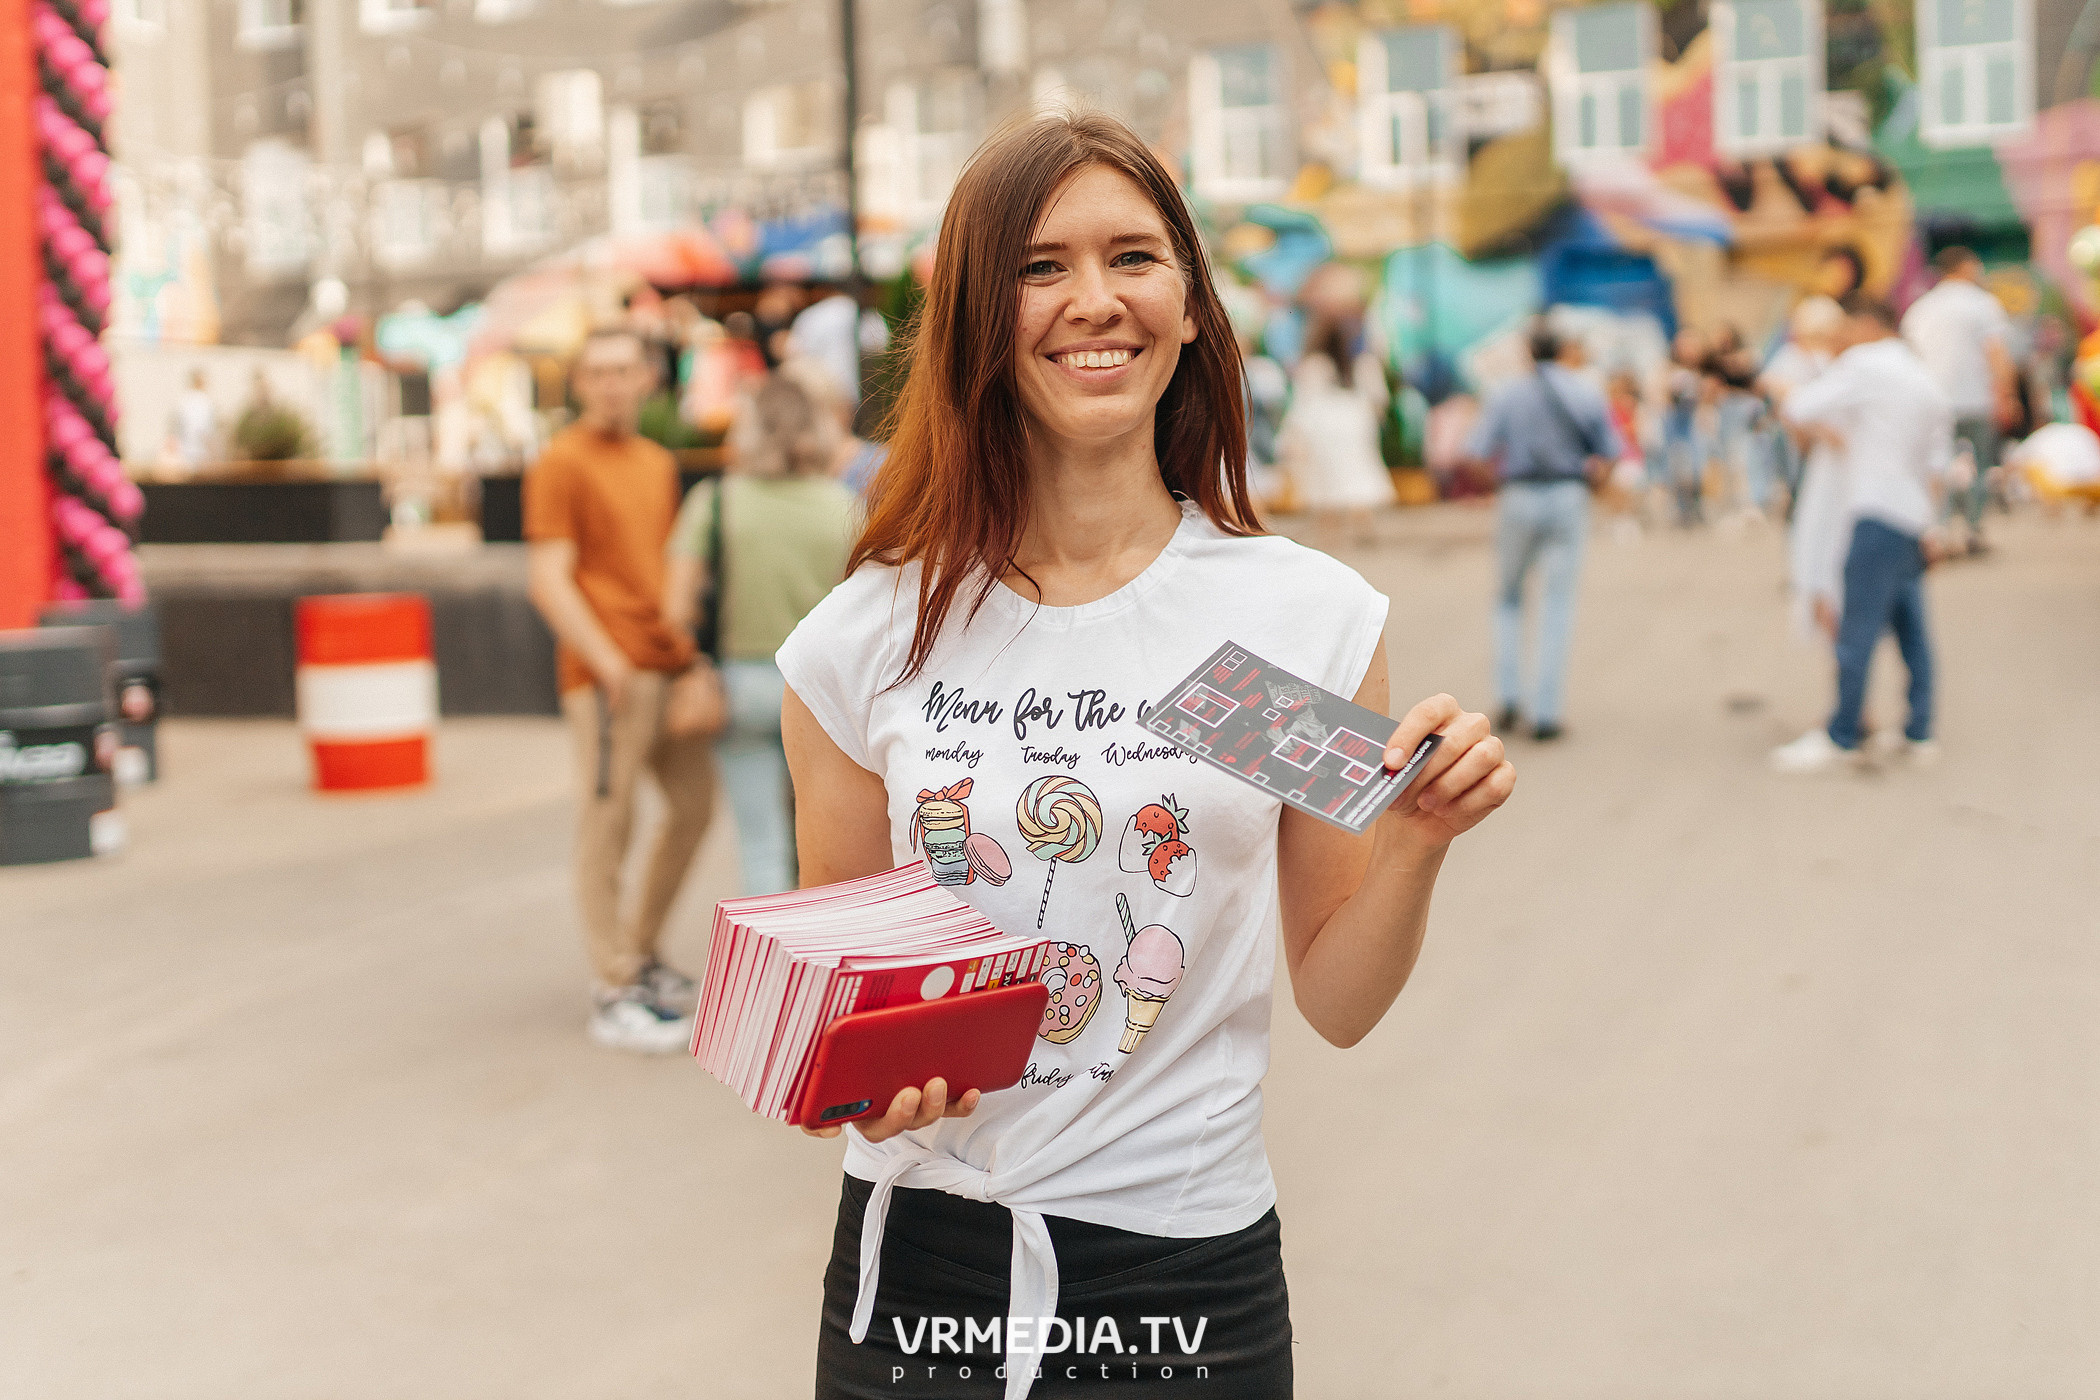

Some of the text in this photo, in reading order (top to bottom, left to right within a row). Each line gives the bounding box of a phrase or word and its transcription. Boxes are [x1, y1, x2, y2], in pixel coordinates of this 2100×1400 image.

[922, 680, 1004, 733] Menu
[1013, 687, 1064, 741] for
[925, 740, 984, 769] monday
